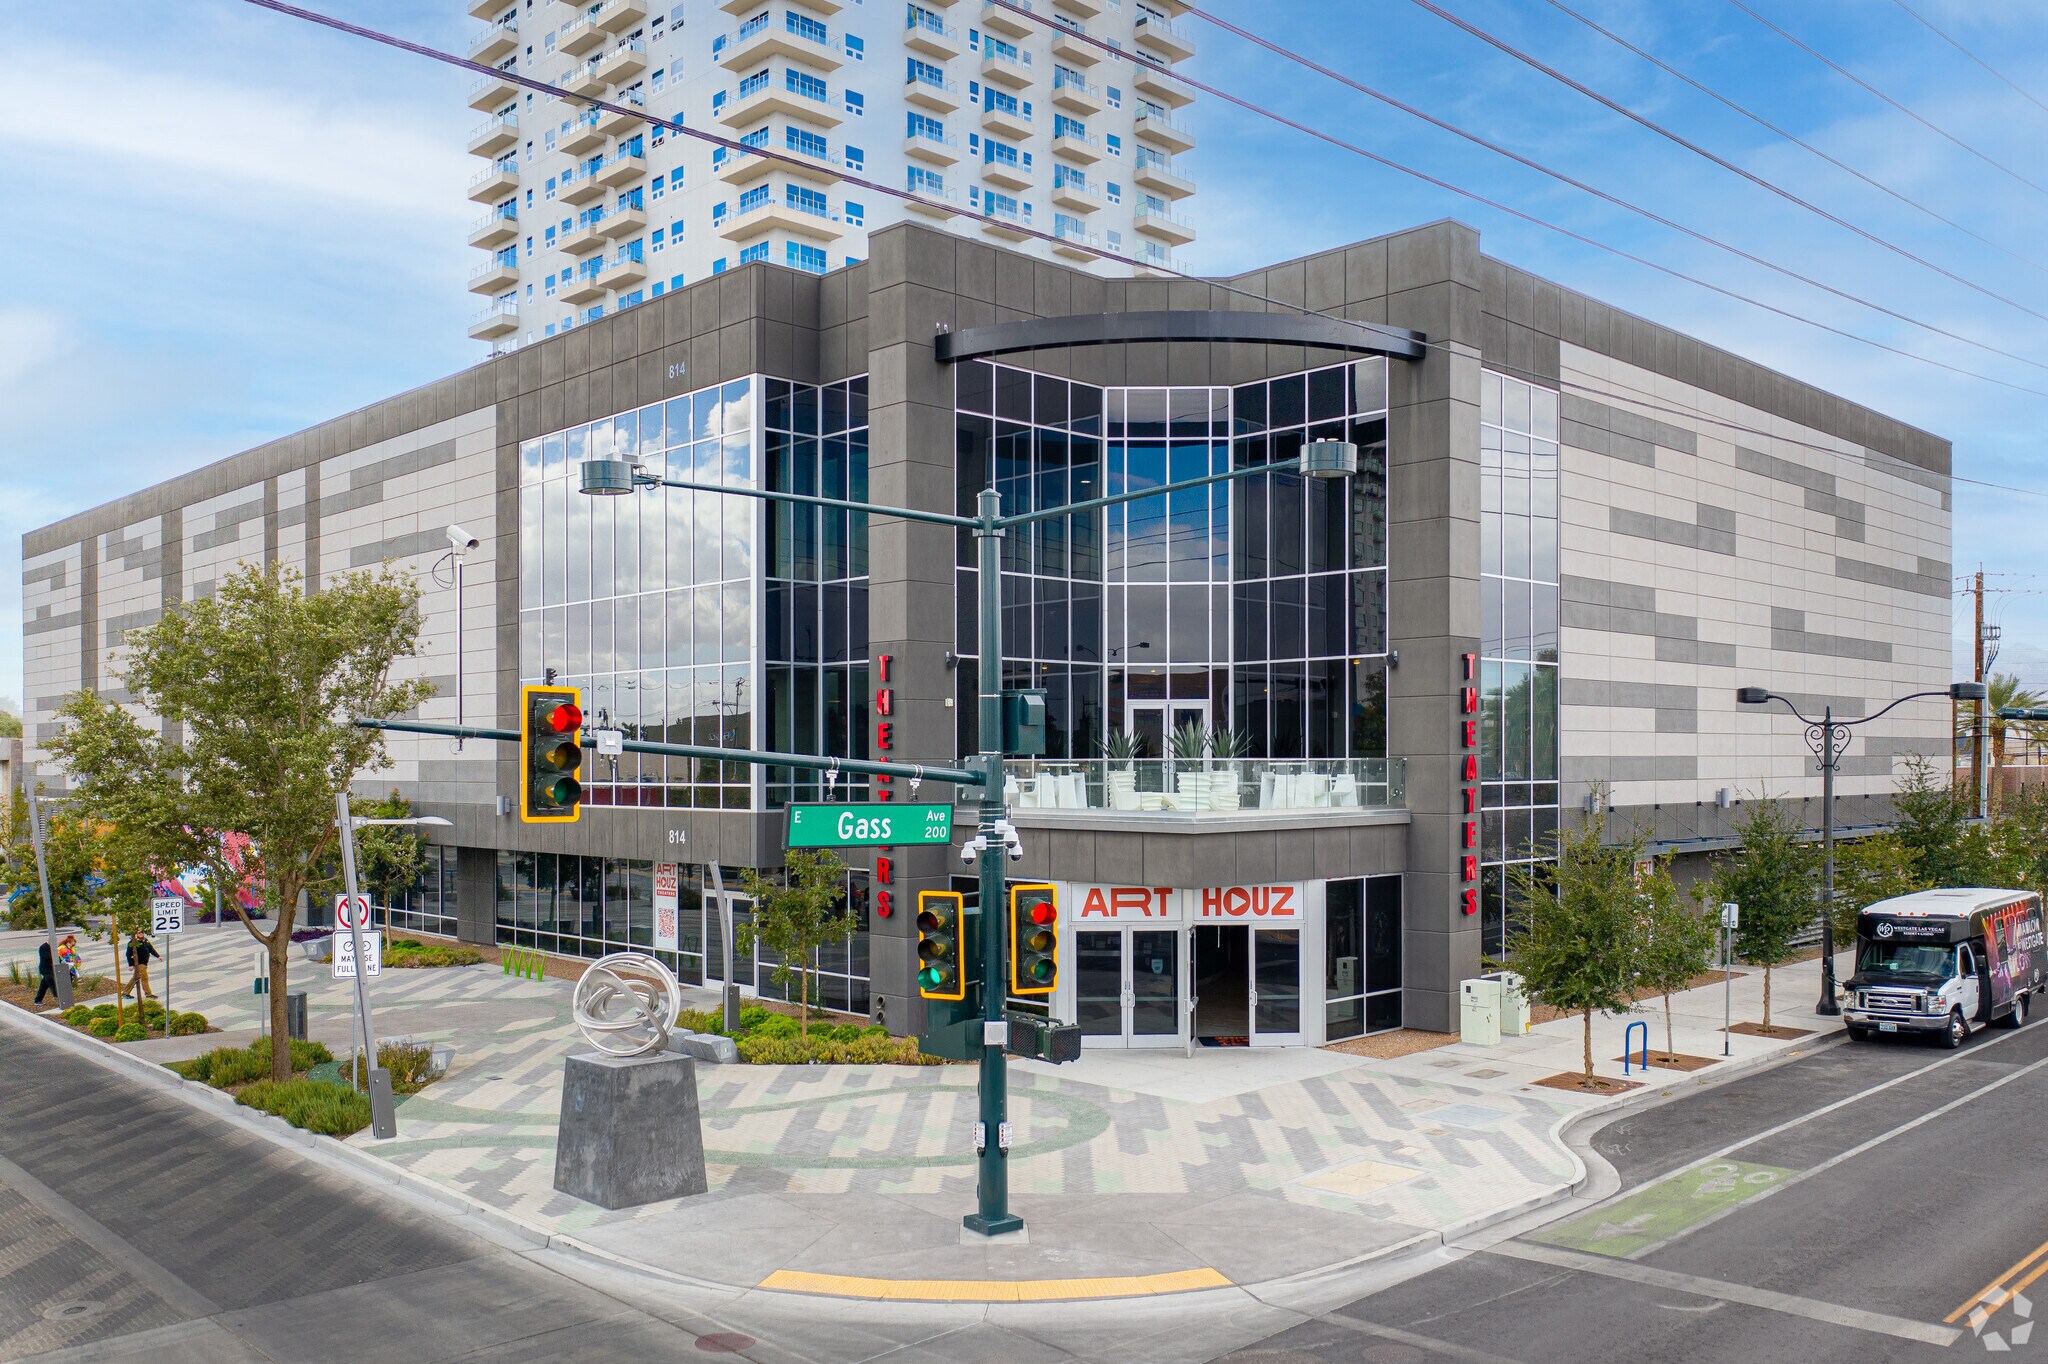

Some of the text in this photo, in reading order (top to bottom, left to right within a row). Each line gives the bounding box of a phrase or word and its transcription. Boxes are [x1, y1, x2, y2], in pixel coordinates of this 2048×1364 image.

[669, 361, 686, 379] 814
[1461, 653, 1477, 916] THEATERS
[794, 809, 946, 840] E Gass Ave
[669, 829, 686, 844] 814
[924, 826, 947, 839] 200
[656, 863, 677, 876] ART
[656, 876, 677, 889] HOUZ
[155, 901, 181, 909] SPEED
[1081, 886, 1295, 917] ART HOUZ
[155, 916, 180, 931] 25
[365, 954, 373, 962] SE
[337, 965, 355, 973] FULL
